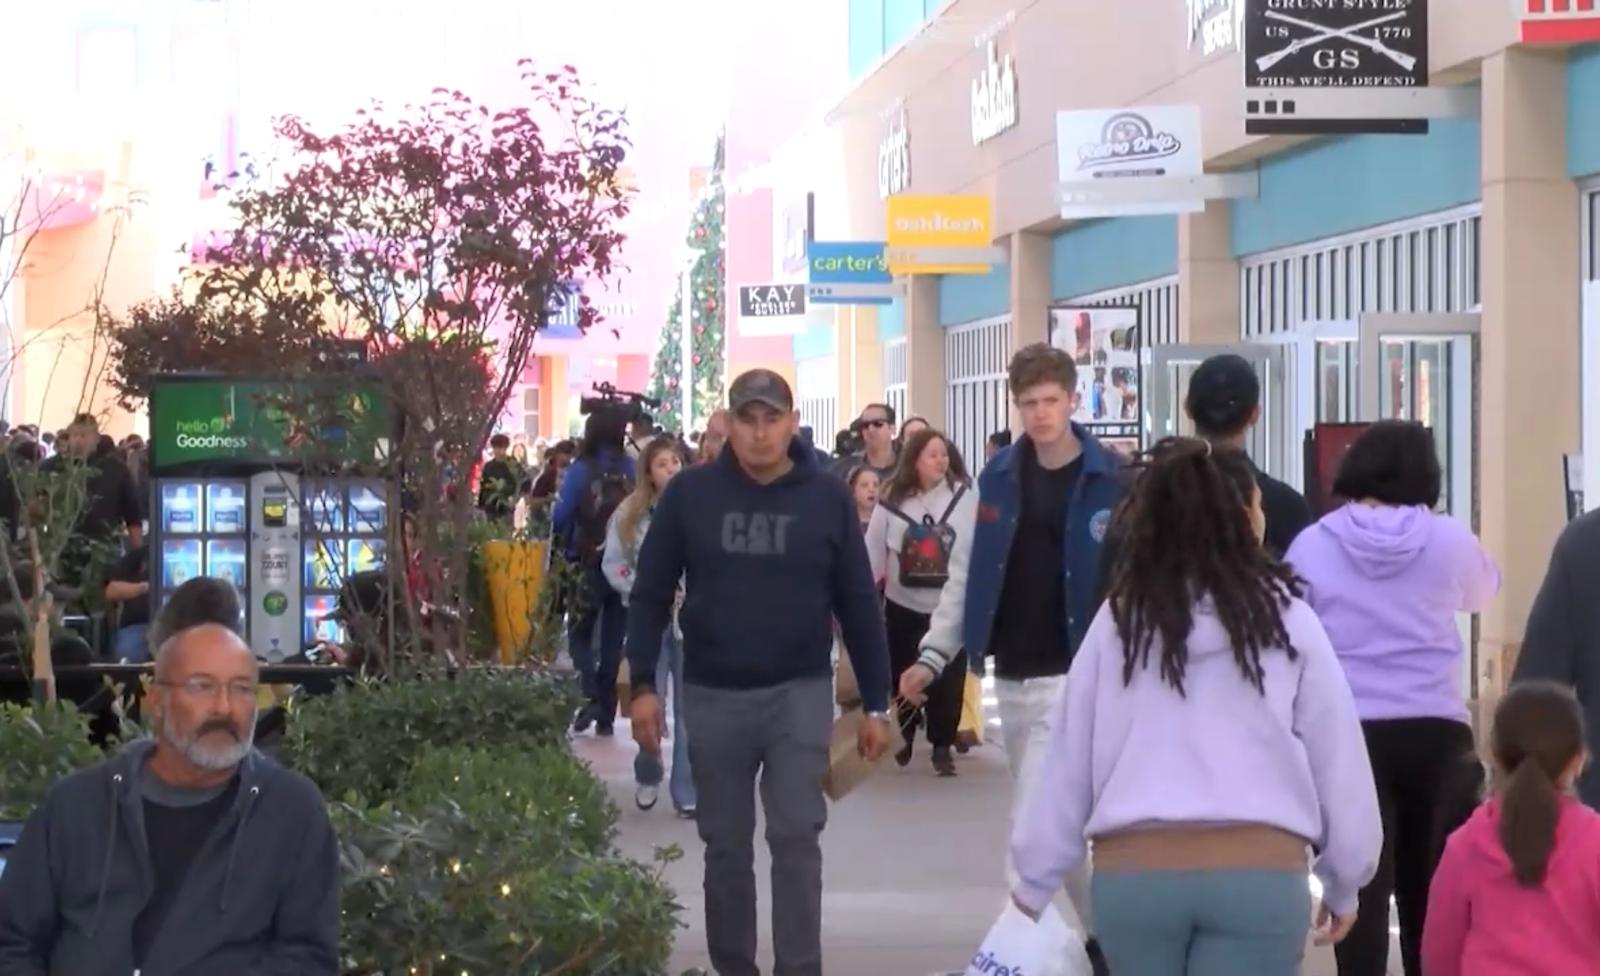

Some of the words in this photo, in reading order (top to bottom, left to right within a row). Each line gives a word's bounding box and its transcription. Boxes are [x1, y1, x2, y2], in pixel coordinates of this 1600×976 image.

[1267, 0, 1338, 9] GRUNT
[1342, 0, 1406, 9] STYLE
[1265, 26, 1290, 38] US
[1373, 27, 1411, 39] 1776
[1312, 48, 1360, 70] GS
[1256, 76, 1295, 87] THIS
[1300, 76, 1348, 87] WE'LL
[1352, 76, 1416, 87] DEFEND
[813, 254, 888, 271] carter's
[748, 285, 795, 302] KAY
[176, 419, 208, 433] hello
[176, 434, 248, 449] Goodness
[721, 511, 795, 555] CAT
[971, 952, 1025, 976] aire'
